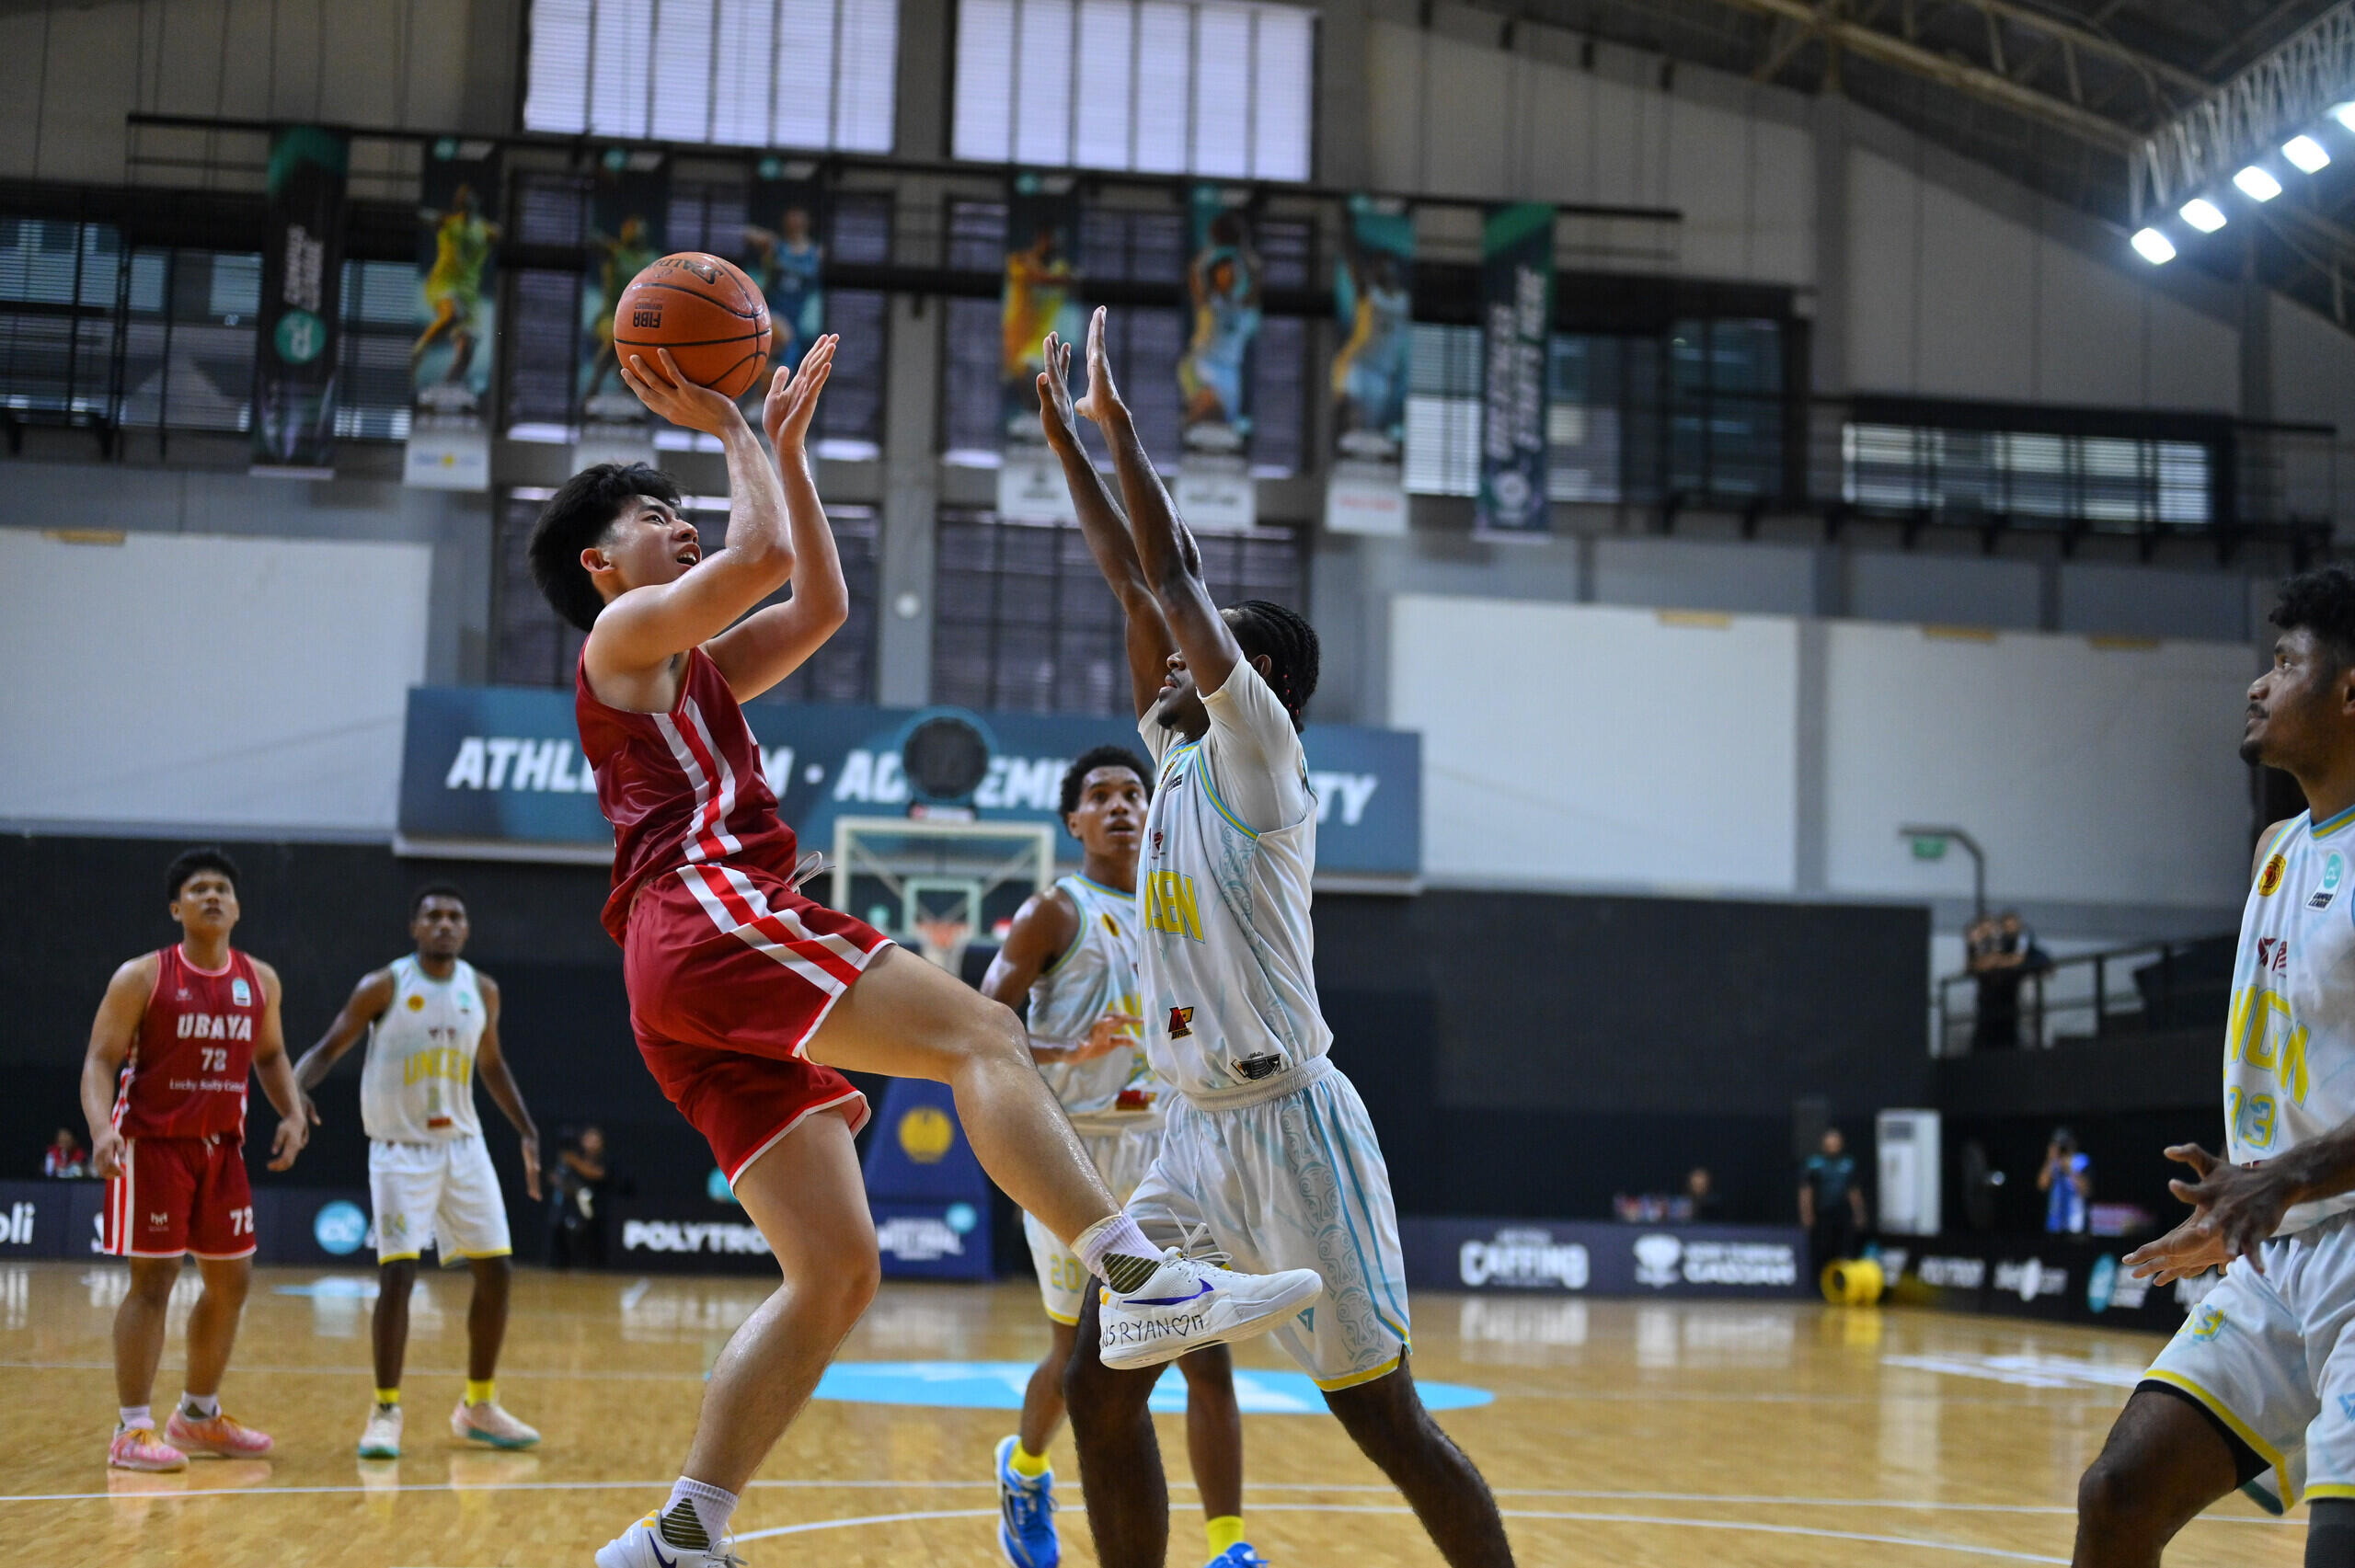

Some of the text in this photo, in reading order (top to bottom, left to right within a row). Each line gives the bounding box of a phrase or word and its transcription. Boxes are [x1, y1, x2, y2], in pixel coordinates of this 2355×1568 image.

[633, 311, 661, 328] FIBA
[177, 1013, 252, 1041] UBAYA
[623, 1220, 773, 1254] POLYTRO
[1050, 1254, 1080, 1290] 20
